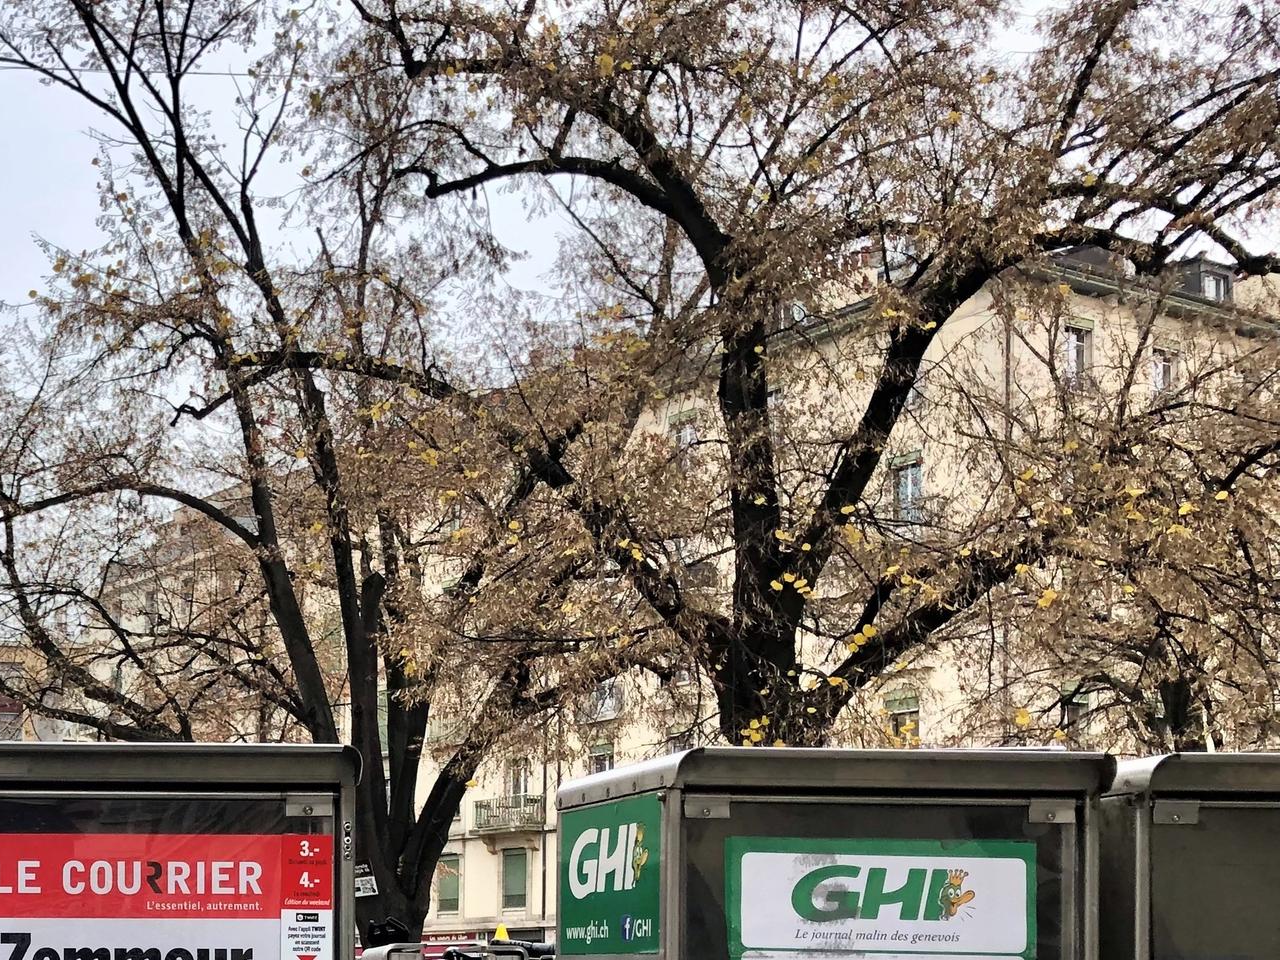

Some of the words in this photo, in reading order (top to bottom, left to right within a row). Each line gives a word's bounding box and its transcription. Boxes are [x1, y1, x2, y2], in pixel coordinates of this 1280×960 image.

[569, 823, 638, 899] GHI
[63, 861, 263, 895] COURRIER
[146, 900, 204, 912] L'essentiel,
[206, 901, 263, 911] autrement.
[791, 864, 948, 923] GHI
[565, 919, 609, 944] www.ghi.ch
[794, 928, 809, 939] Le
[810, 928, 855, 945] journal
[855, 929, 888, 941] malin
[890, 929, 909, 942] des
[910, 931, 961, 945] genevois
